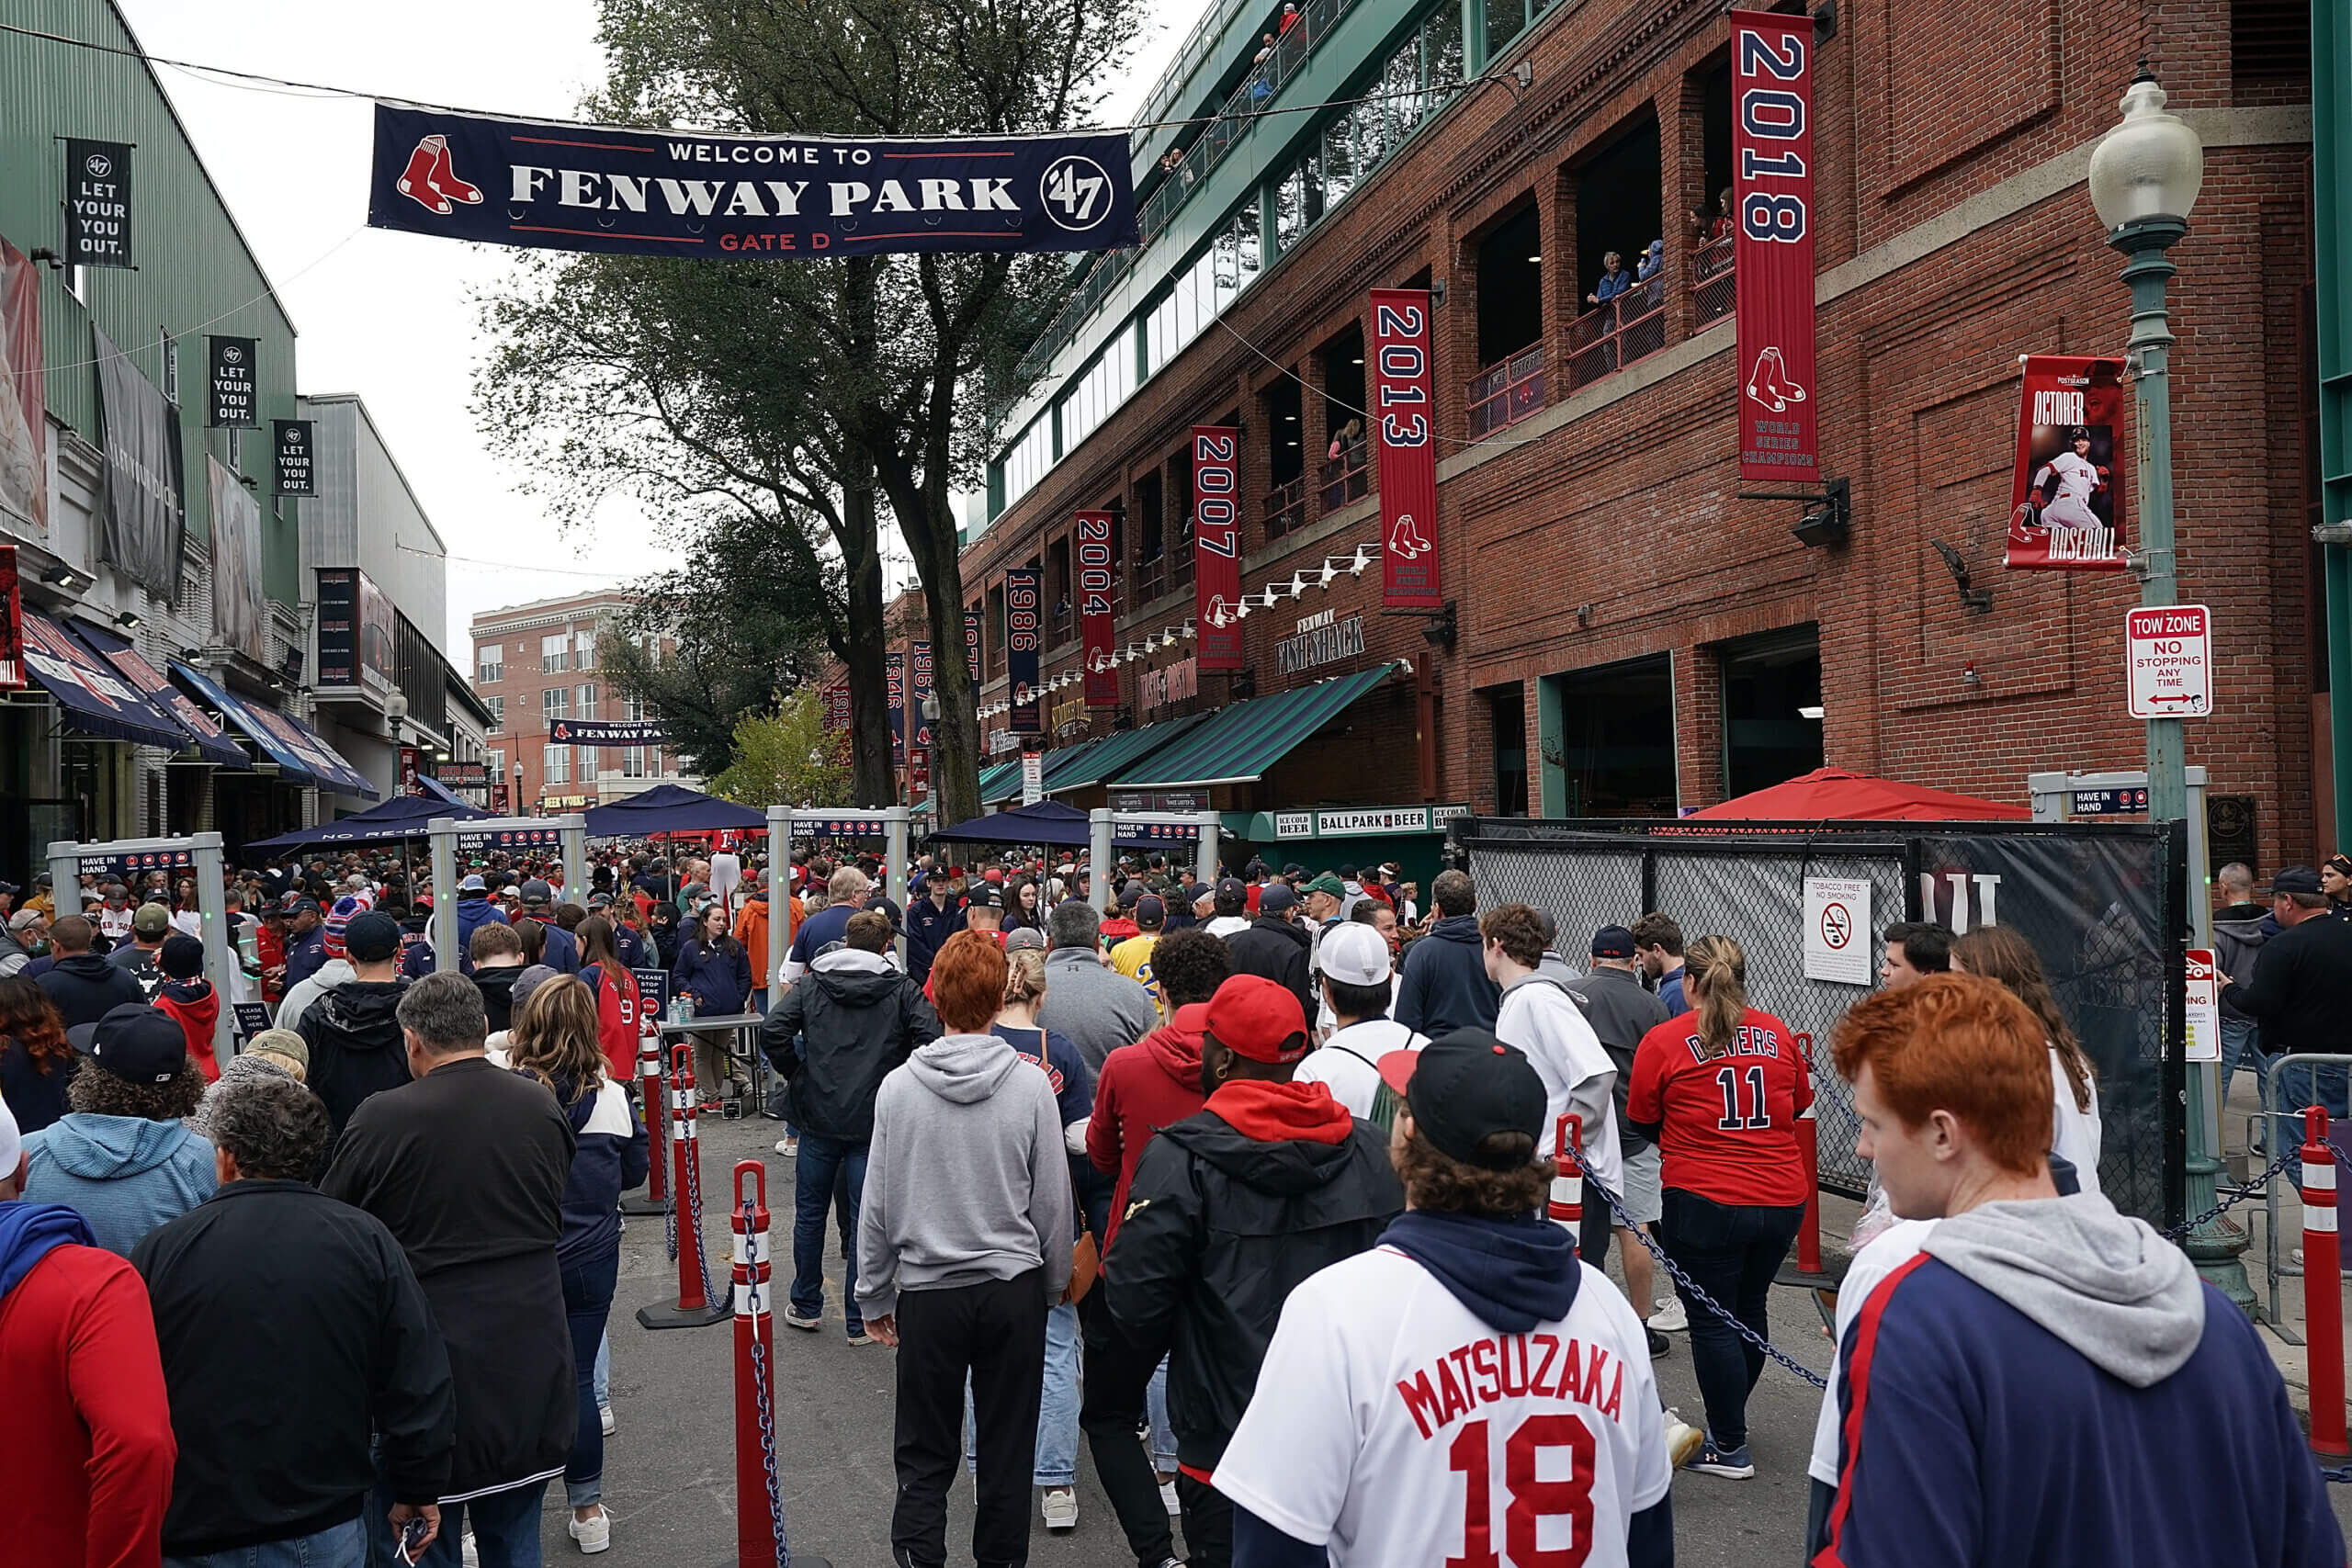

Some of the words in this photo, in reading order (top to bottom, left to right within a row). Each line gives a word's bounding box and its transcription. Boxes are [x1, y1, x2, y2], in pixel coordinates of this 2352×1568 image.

[1740, 29, 1805, 243] 2018
[669, 142, 819, 164] WELCOME
[833, 149, 871, 165] TO
[82, 182, 117, 198] LET
[510, 165, 808, 216] FENWAY
[829, 178, 1021, 216] PARK
[74, 199, 125, 218] YOUR
[81, 220, 119, 235] YOU
[81, 239, 122, 254] OUT.
[720, 233, 796, 250] GATE
[813, 232, 830, 249] D
[220, 367, 245, 378] LET
[1378, 306, 1427, 447] 2013
[214, 380, 252, 393] YOUR
[220, 394, 247, 406] YOU
[219, 408, 250, 420] OUT.
[2033, 390, 2084, 425] OCTOBER
[1755, 420, 1800, 434] WORLD
[1757, 436, 1799, 449] SERIES
[283, 446, 304, 455] LET
[278, 457, 310, 467] YOUR
[1742, 451, 1814, 467] CHAMPIONS
[283, 468, 306, 478] YOU
[283, 480, 309, 490] OUT.
[1198, 435, 1235, 558] 2007
[2049, 527, 2117, 560] BASEBALL
[1079, 520, 1110, 615] 2004
[1010, 575, 1036, 650] 1986
[1297, 608, 1335, 634] FENWAY
[2133, 617, 2163, 635] TOW
[2165, 615, 2201, 633] ZONE
[1275, 634, 1308, 676] FISH
[1310, 616, 1364, 666] SHACK
[2154, 641, 2182, 655] NO
[2136, 656, 2201, 668] STOPPING
[2157, 669, 2181, 677] ANY
[2156, 678, 2183, 687] TIME
[832, 690, 850, 729] 1915
[577, 728, 639, 739] FENWAY
[438, 766, 461, 777] RED
[462, 765, 485, 777] SOX
[544, 797, 561, 808] BEER
[562, 795, 586, 807] WORKS
[2077, 793, 2098, 802] HAVE
[2101, 792, 2110, 801] IN
[1446, 807, 1465, 816] COLD
[2077, 802, 2101, 812] HAND
[1291, 816, 1308, 824] COLD
[1320, 815, 1383, 829] BALLPARK
[1395, 813, 1425, 827] BEER
[1280, 824, 1308, 834] BEER
[460, 841, 484, 850] HAND
[81, 857, 105, 866] HAVE
[107, 856, 117, 864] IN
[82, 865, 107, 874] HAND
[1813, 883, 1842, 891] TOBACCO
[1844, 884, 1860, 892] FREE
[1827, 892, 1857, 900] SMOKING
[1685, 1026, 1778, 1065] DVERS
[1716, 1066, 1770, 1130] 11
[1396, 1334, 1623, 1440] MATSUZAKA
[1445, 1414, 1596, 1568] 18
